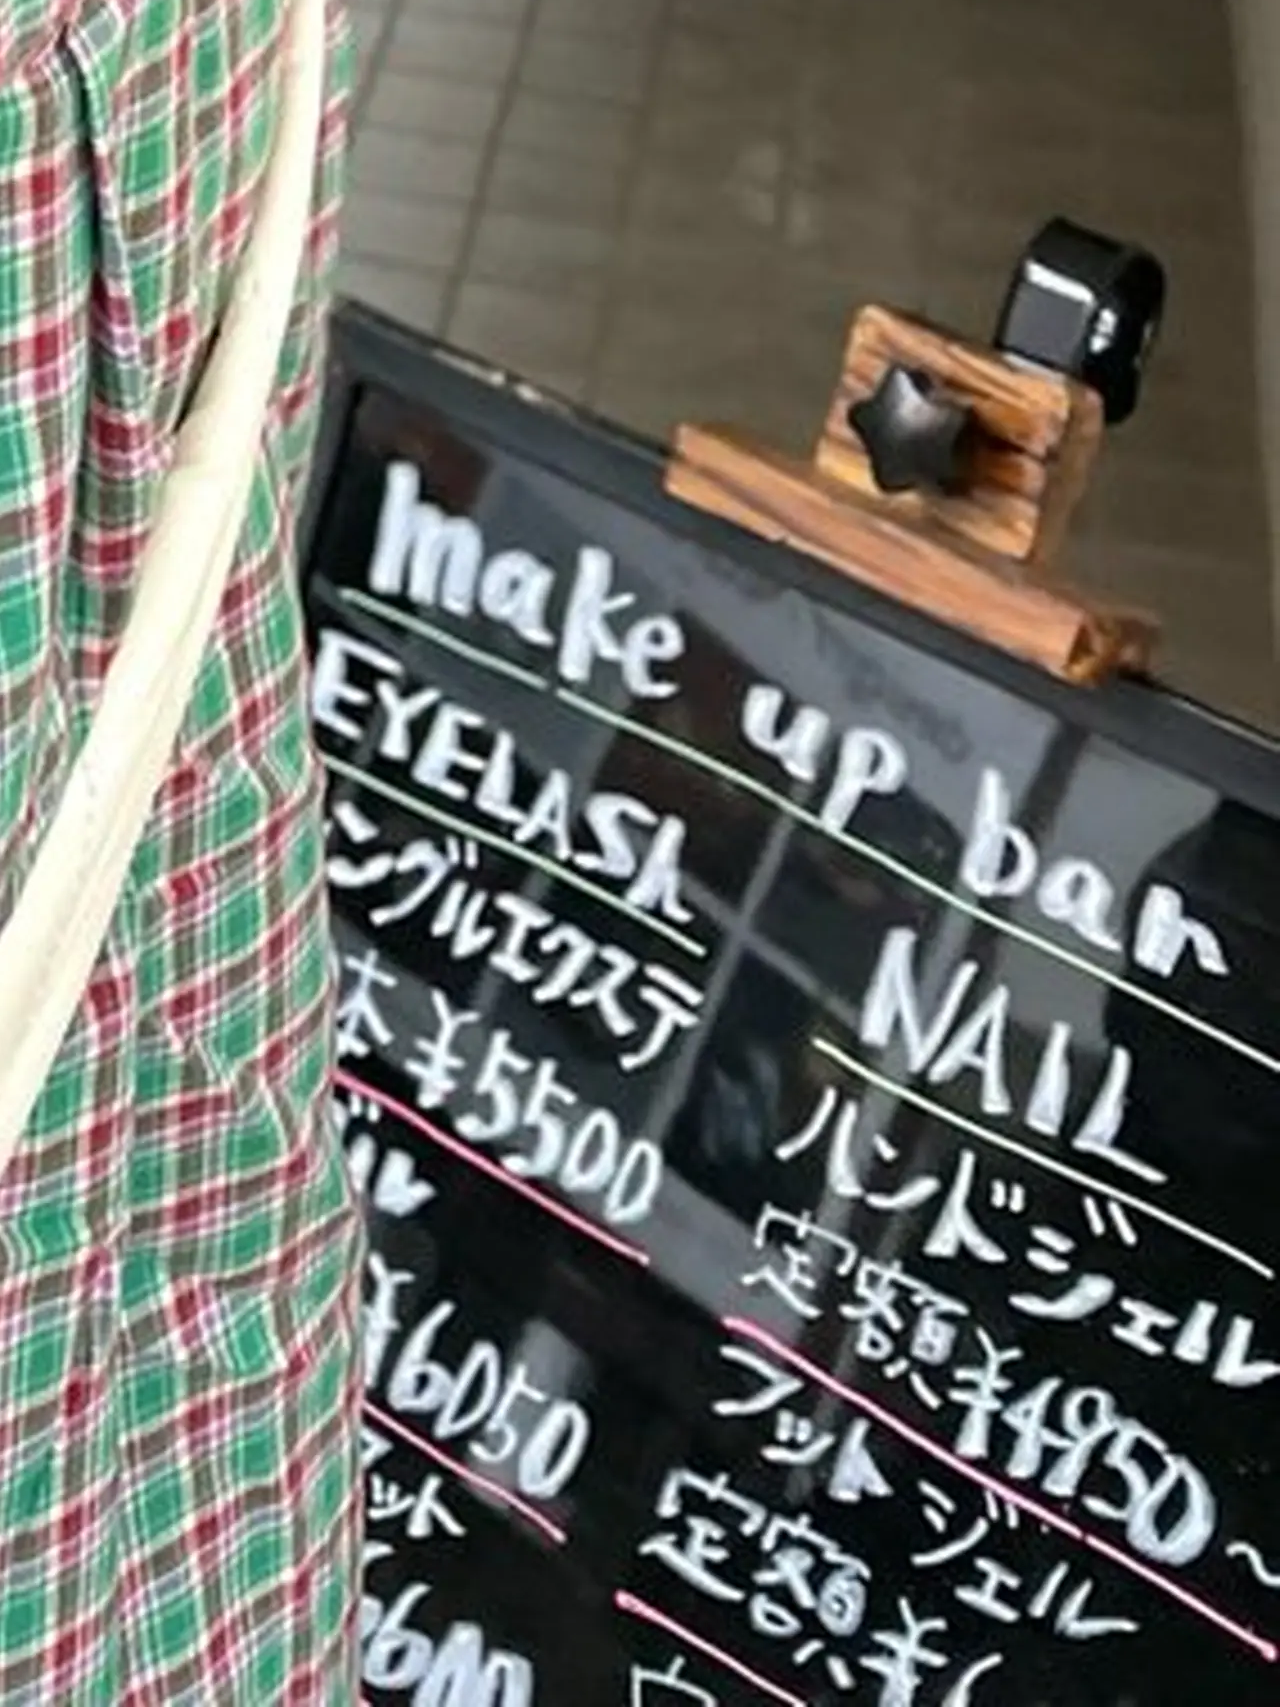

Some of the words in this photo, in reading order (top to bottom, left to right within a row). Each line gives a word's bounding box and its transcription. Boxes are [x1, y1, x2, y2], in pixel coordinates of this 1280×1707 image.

[368, 460, 684, 698] make
[743, 684, 908, 833] up
[322, 800, 705, 1071] ングルエクステ
[860, 926, 1168, 1184] NAIL
